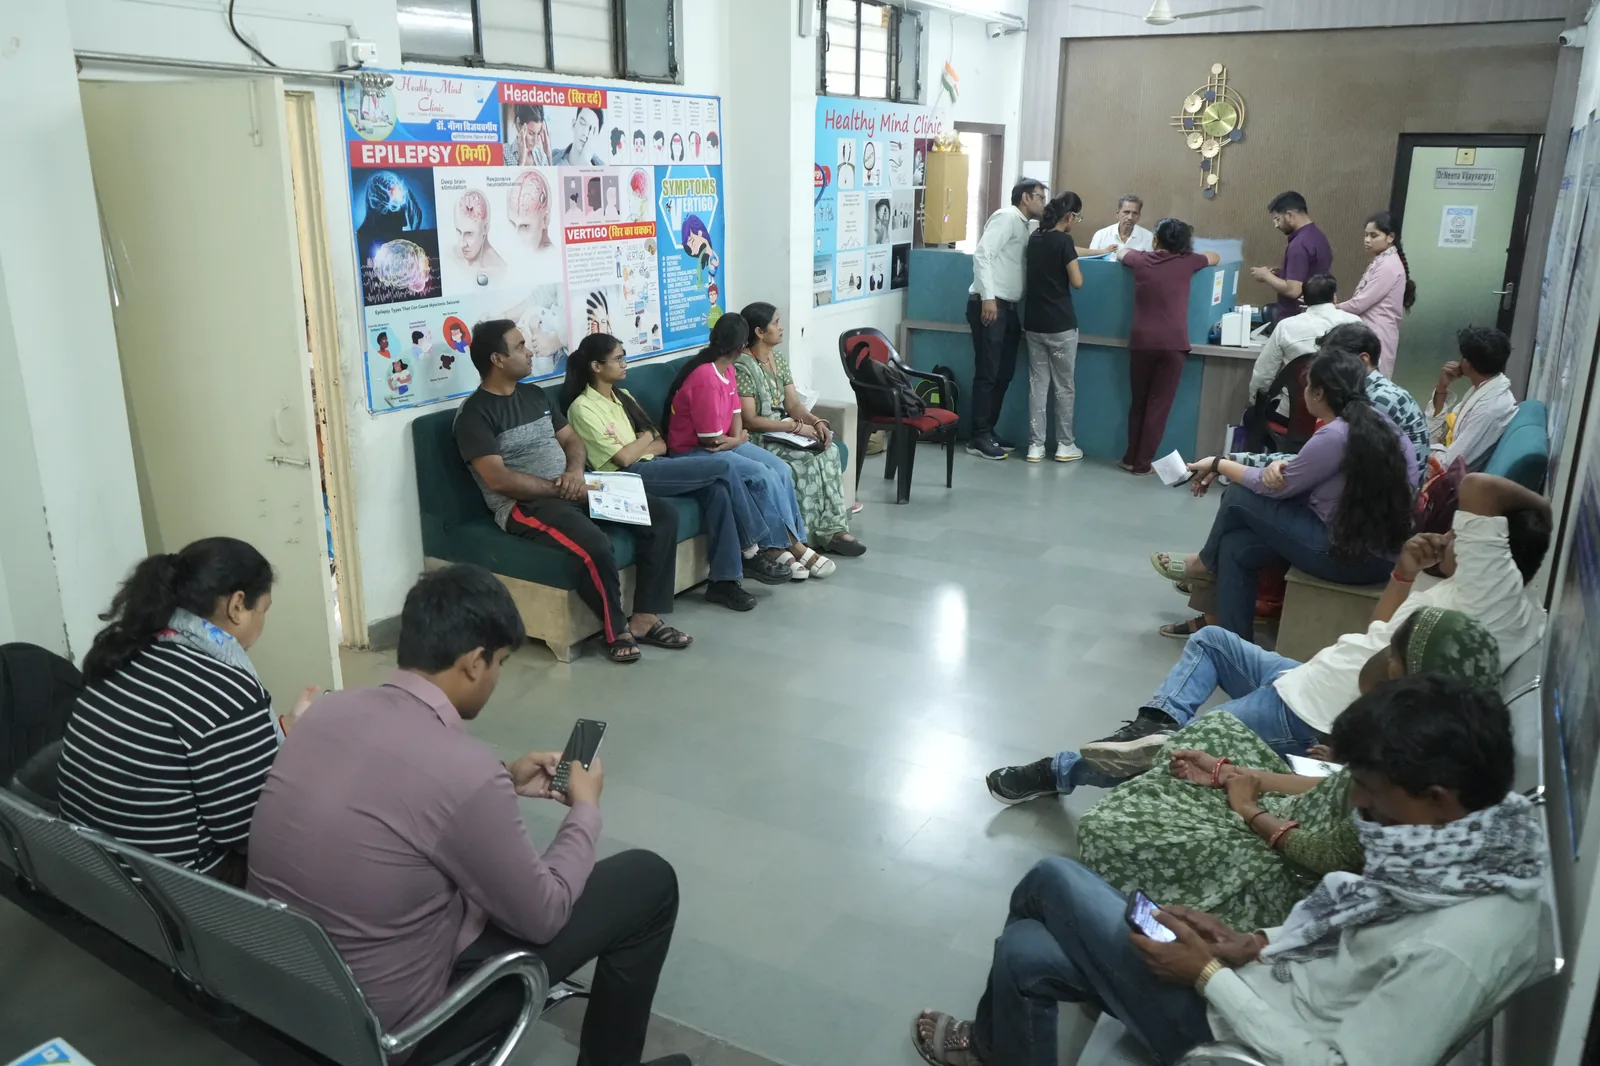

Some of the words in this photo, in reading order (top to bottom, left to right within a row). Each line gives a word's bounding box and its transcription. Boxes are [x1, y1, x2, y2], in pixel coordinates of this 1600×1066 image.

[396, 76, 432, 95] Healthy
[435, 79, 462, 95] Mind
[504, 84, 565, 104] Headache
[417, 97, 444, 113] Clinic
[825, 109, 875, 138] Healthy
[879, 113, 909, 133] Mind
[913, 115, 942, 135] Clinic
[361, 144, 452, 164] EPILEPSY
[662, 178, 716, 196] SYMPTOMS
[670, 197, 713, 231] VERTIGO
[566, 227, 608, 240] VERTIGO
